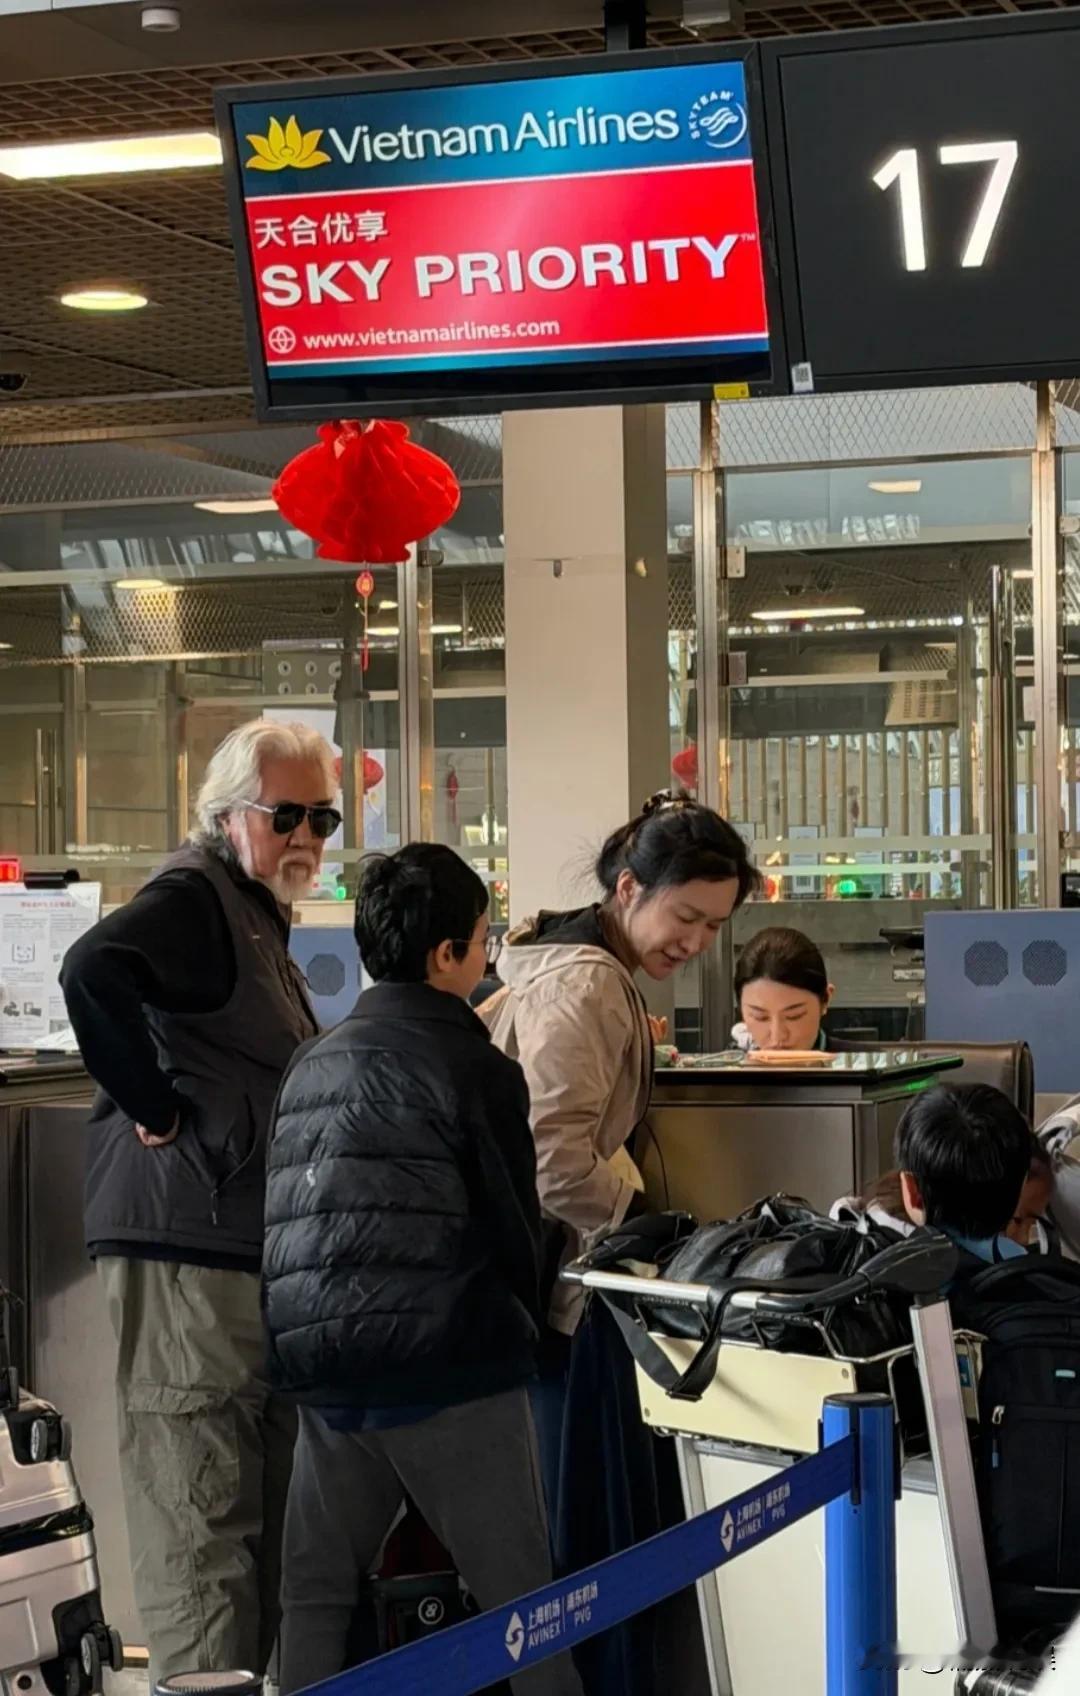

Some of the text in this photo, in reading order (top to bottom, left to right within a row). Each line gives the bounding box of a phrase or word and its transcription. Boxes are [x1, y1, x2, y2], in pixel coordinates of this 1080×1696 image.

[328, 107, 680, 164] Vietnam Airlines
[873, 140, 1018, 271] 17
[254, 210, 388, 249] 天合优享
[261, 258, 391, 307] SKY
[303, 319, 560, 349] www.vietnamairlines.com
[528, 1606, 592, 1650] AVINEX PVG
